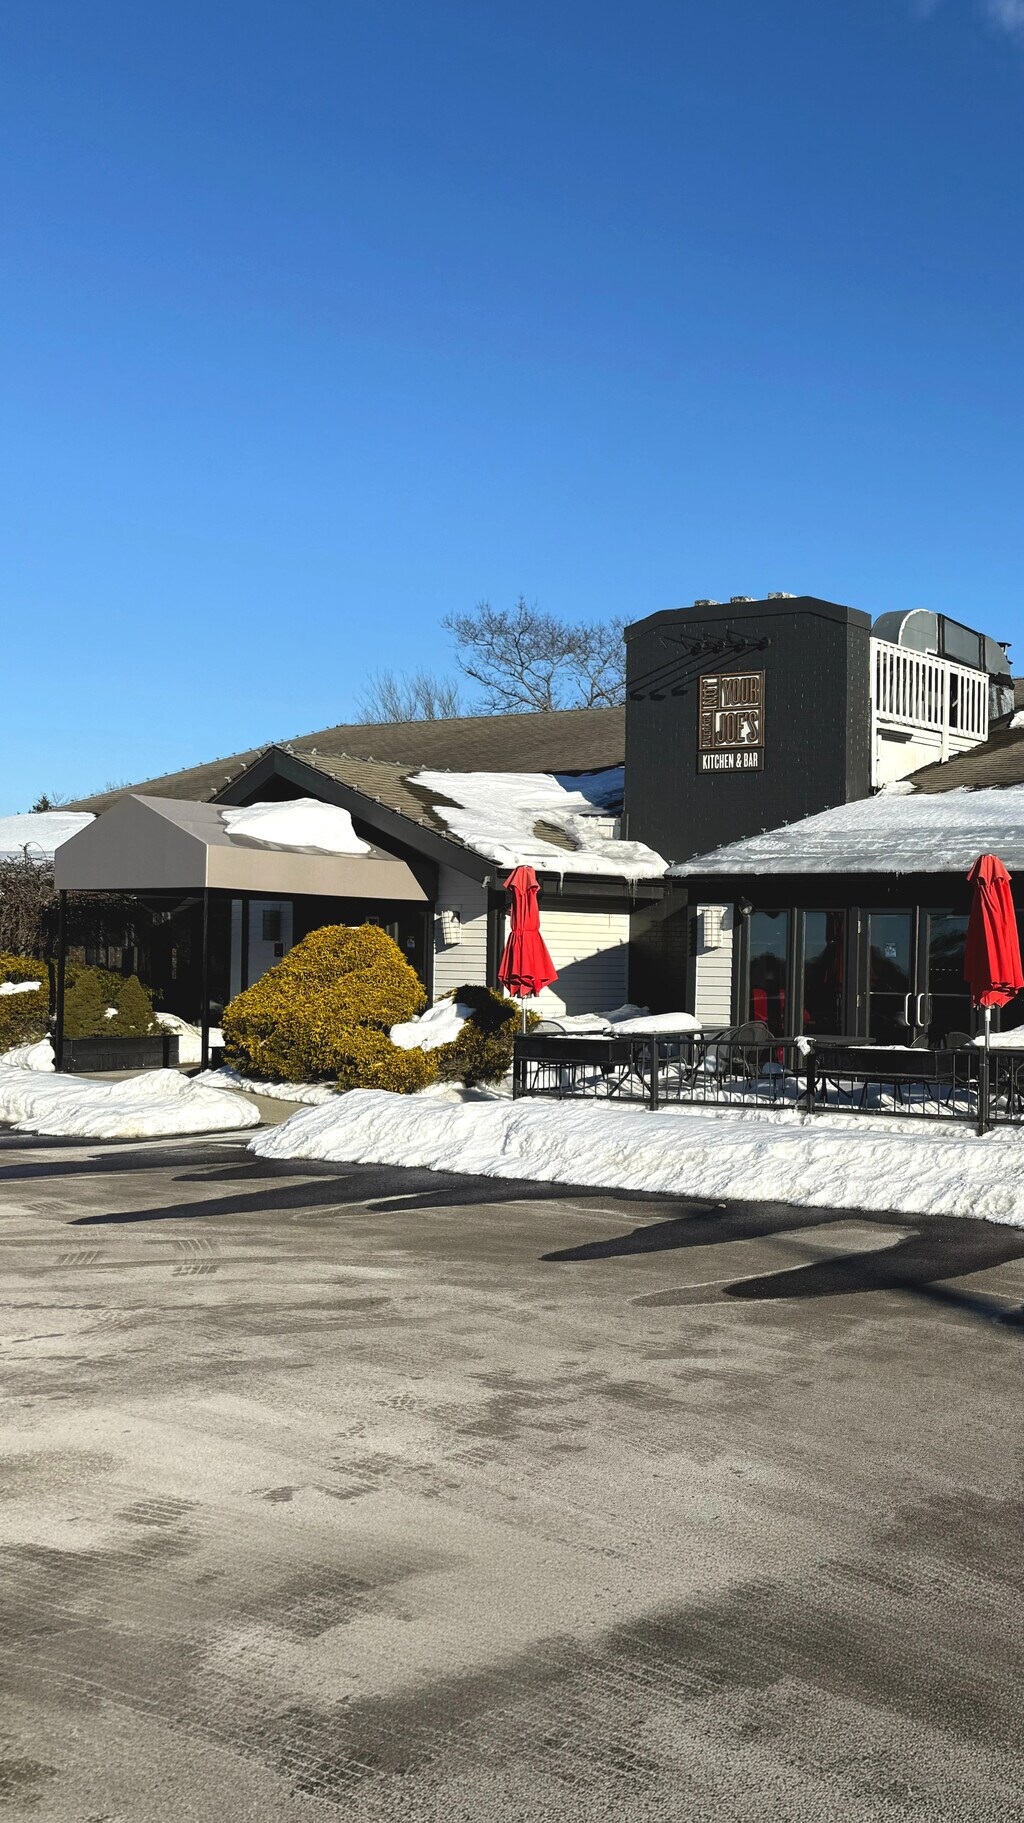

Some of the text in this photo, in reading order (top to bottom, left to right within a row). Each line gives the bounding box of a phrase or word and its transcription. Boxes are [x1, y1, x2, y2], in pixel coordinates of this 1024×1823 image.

[703, 681, 717, 706] NOT
[722, 677, 759, 706] YOUR
[716, 711, 758, 743] JOE'S
[703, 752, 758, 769] KITCHEN & BAR
